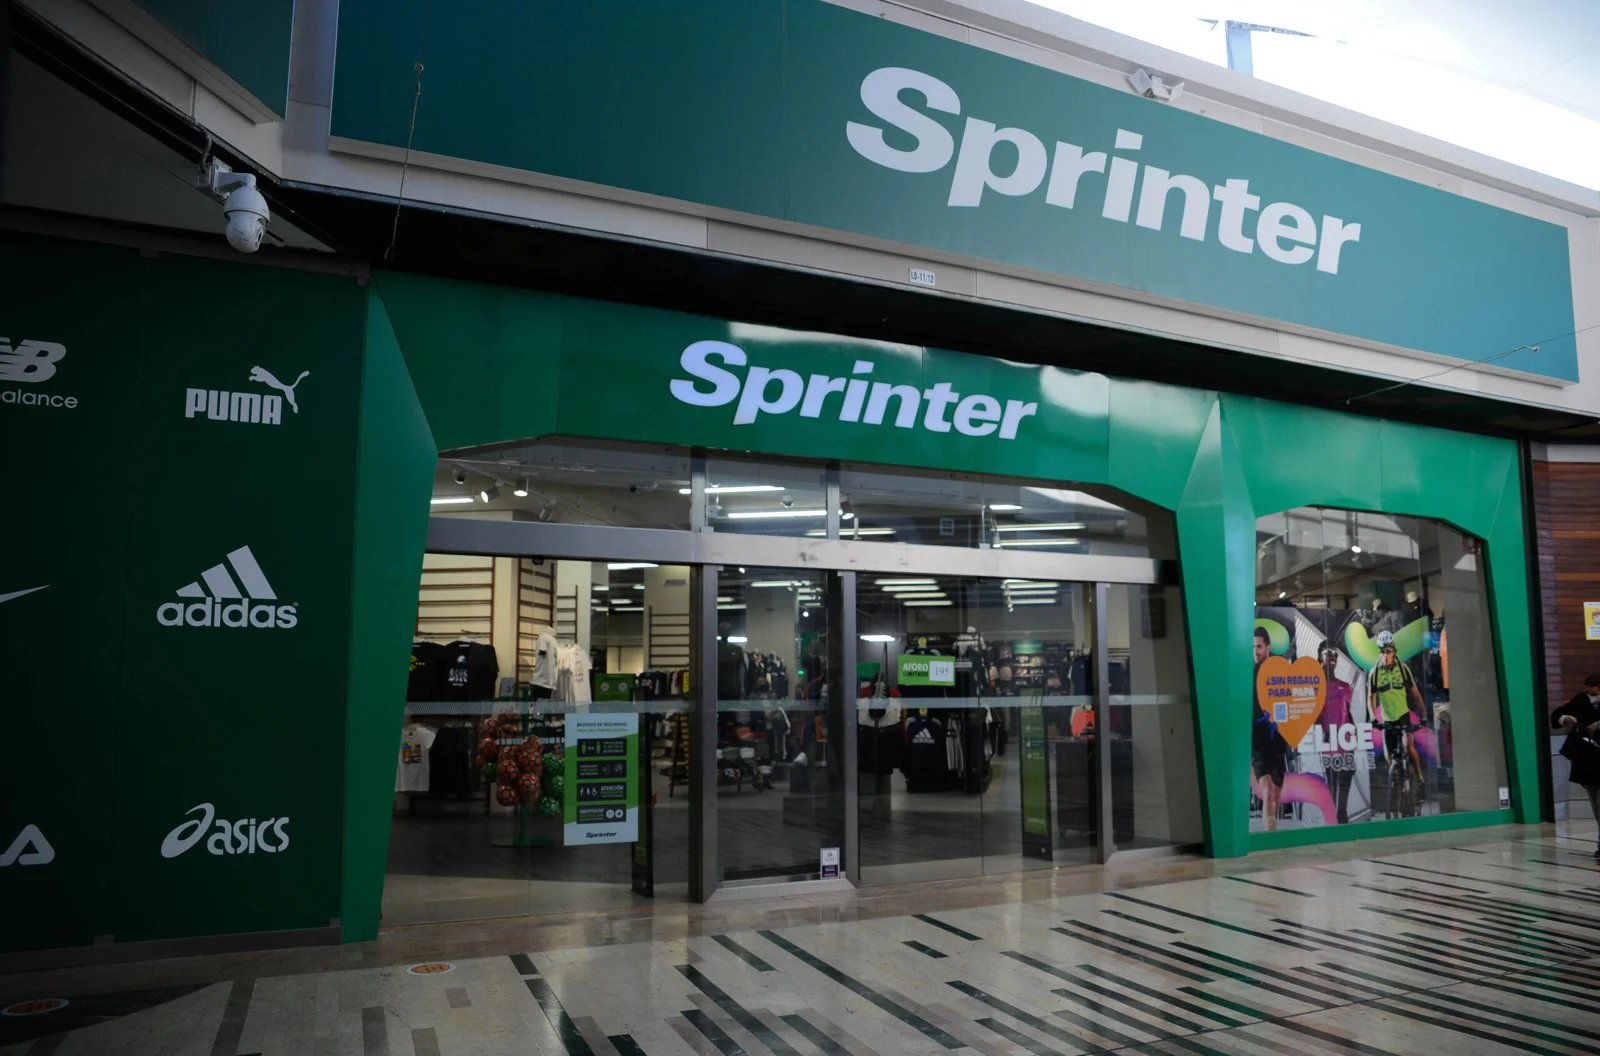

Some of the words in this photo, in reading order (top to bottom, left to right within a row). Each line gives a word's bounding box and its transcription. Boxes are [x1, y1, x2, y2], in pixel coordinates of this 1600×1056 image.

[846, 66, 1362, 275] Sprinter
[0, 388, 79, 409] alance
[669, 340, 1038, 440] Sprinter
[185, 387, 282, 425] PUMA
[156, 597, 298, 629] adidas
[903, 662, 929, 671] AFORO
[935, 666, 949, 677] 195
[1287, 675, 1320, 685] REGALO
[1268, 688, 1292, 697] PARA
[206, 816, 290, 856] asics
[585, 831, 618, 839] Sprinter
